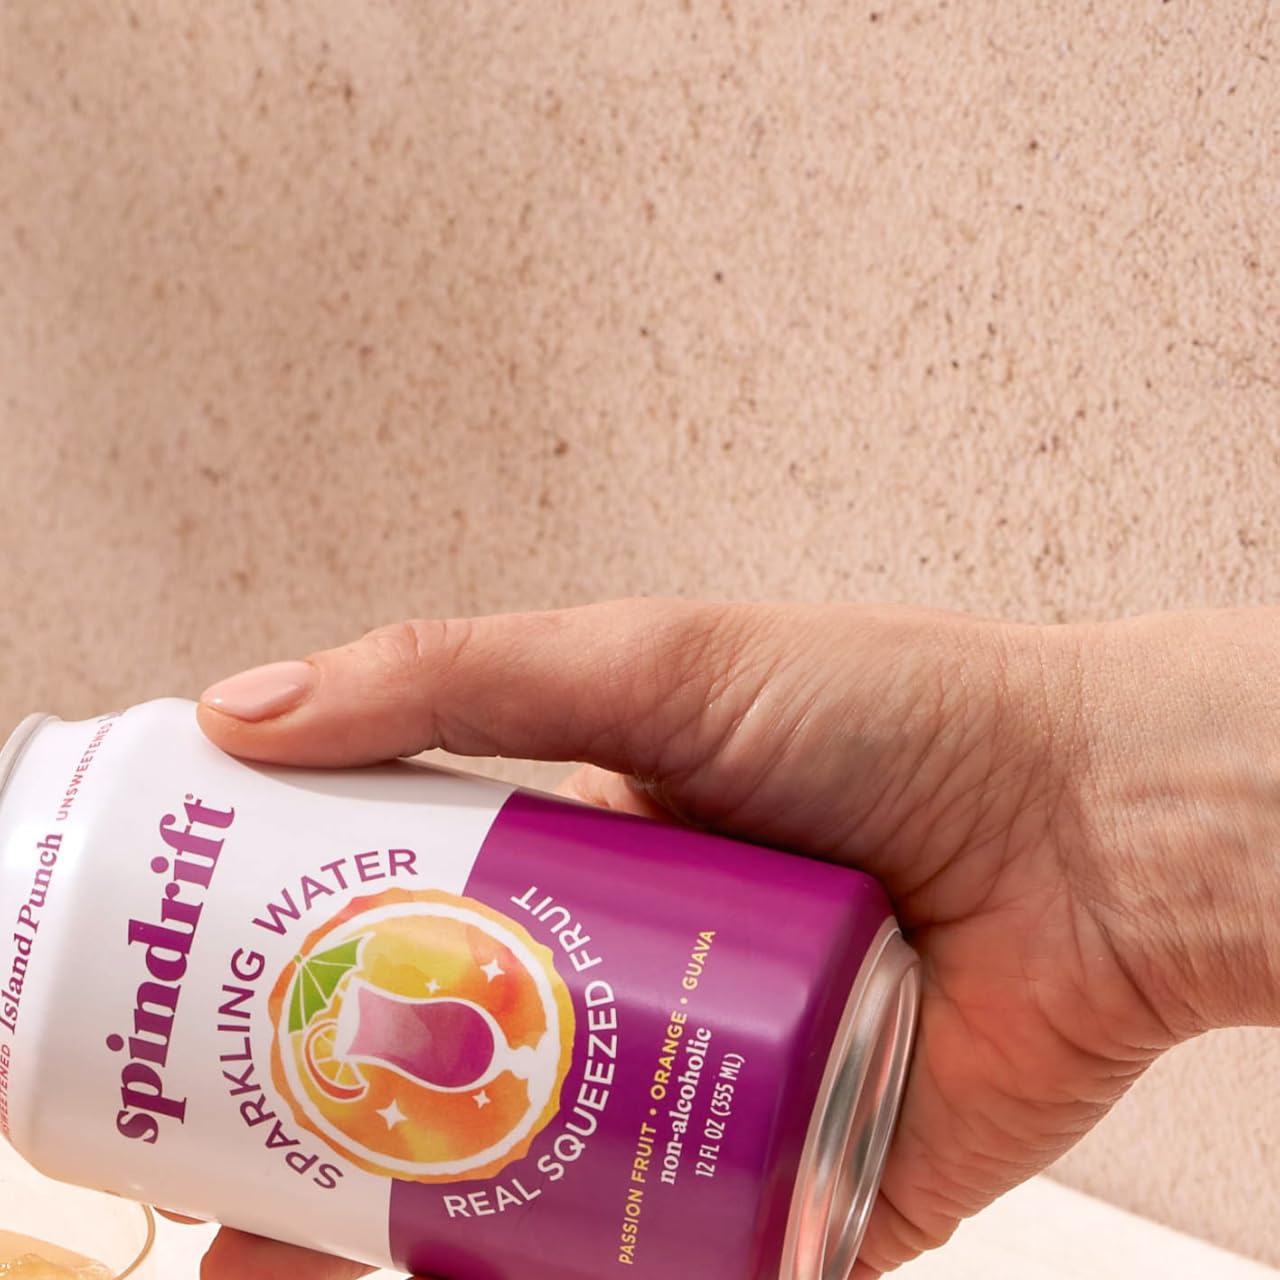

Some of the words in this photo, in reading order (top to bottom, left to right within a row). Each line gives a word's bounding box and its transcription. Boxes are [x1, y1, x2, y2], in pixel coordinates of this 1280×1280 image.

[17, 833, 64, 934] Punch
[252, 848, 418, 936] WATER
[106, 798, 235, 1144] spindrift
[510, 886, 602, 972] FRUIT
[217, 947, 344, 1190] SPARKLING
[537, 979, 618, 1182] SQUEEZED
[619, 1188, 643, 1265] PASSION
[631, 1122, 656, 1183] FRUIT
[650, 1011, 688, 1100] ORANGE
[682, 930, 716, 990] GUAVA
[661, 1027, 711, 1185] non-alcoholic
[710, 1082, 735, 1117] (355
[719, 1053, 746, 1081] ML)
[695, 1161, 716, 1178] 12
[699, 1144, 720, 1160] FL
[704, 1118, 725, 1140] OZ
[443, 1177, 541, 1218] REAL
